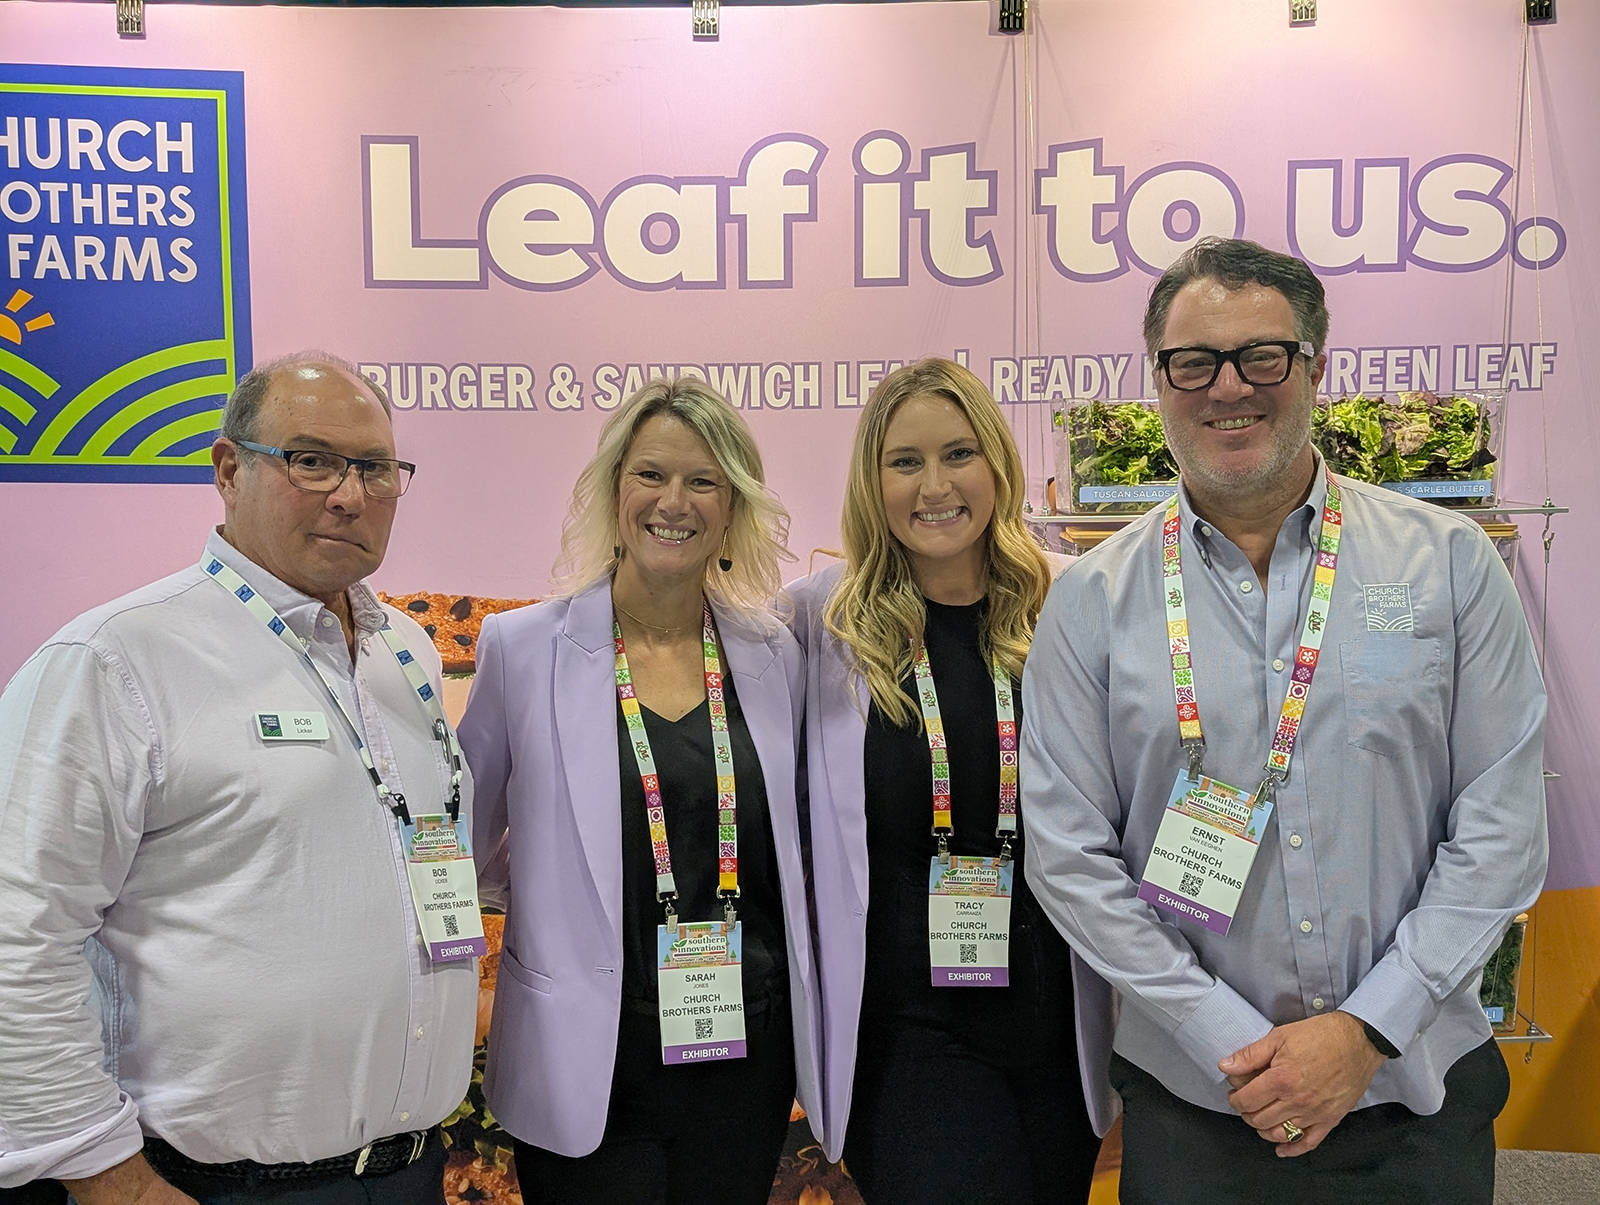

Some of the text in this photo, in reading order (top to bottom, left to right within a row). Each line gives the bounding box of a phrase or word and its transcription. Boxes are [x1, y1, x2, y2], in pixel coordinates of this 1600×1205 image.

[0, 116, 194, 173] HURCH
[0, 181, 196, 227] OTHERS
[361, 130, 1567, 292] Leaf it to us.
[8, 234, 198, 283] FARMS
[1317, 342, 1557, 394] REEN LEAF
[990, 354, 1133, 404] READY
[358, 362, 538, 411] BURGER
[547, 363, 584, 411] &
[1406, 486, 1447, 494] SCARLET
[1448, 484, 1486, 493] BUTTER
[1093, 491, 1131, 499] TUSCAN
[1133, 490, 1171, 498] SALADS
[1368, 587, 1406, 595] CHURCH
[294, 718, 312, 726] BOB
[1208, 793, 1250, 815] southern
[1194, 797, 1247, 822] innovations
[424, 829, 455, 838] southern
[1192, 826, 1226, 846] ERNST
[417, 837, 456, 847] innovations
[1189, 836, 1200, 844] VAN
[1180, 845, 1224, 869] CHURCH
[432, 868, 448, 877] BOB
[959, 868, 997, 877] southern
[1153, 846, 1243, 890] BROTHERS FARMS
[948, 874, 997, 883] innovations
[432, 891, 457, 900] CHURCH
[424, 899, 474, 911] BROTHERS FARMS
[954, 901, 985, 910] TRACY
[1157, 893, 1210, 922] EXHIBITOR
[950, 921, 987, 930] CHURCH
[688, 936, 726, 945] southern
[930, 932, 1008, 941] BROTHERS FARMS
[440, 944, 475, 958] EXHIBITOR
[677, 944, 726, 954] innovations
[685, 973, 716, 983] SARAH
[948, 972, 992, 981] EXHIBITOR
[683, 993, 721, 1004] CHURCH
[662, 1003, 743, 1018] BROTHERS FARMS
[682, 1047, 729, 1060] EXHIBITOR
